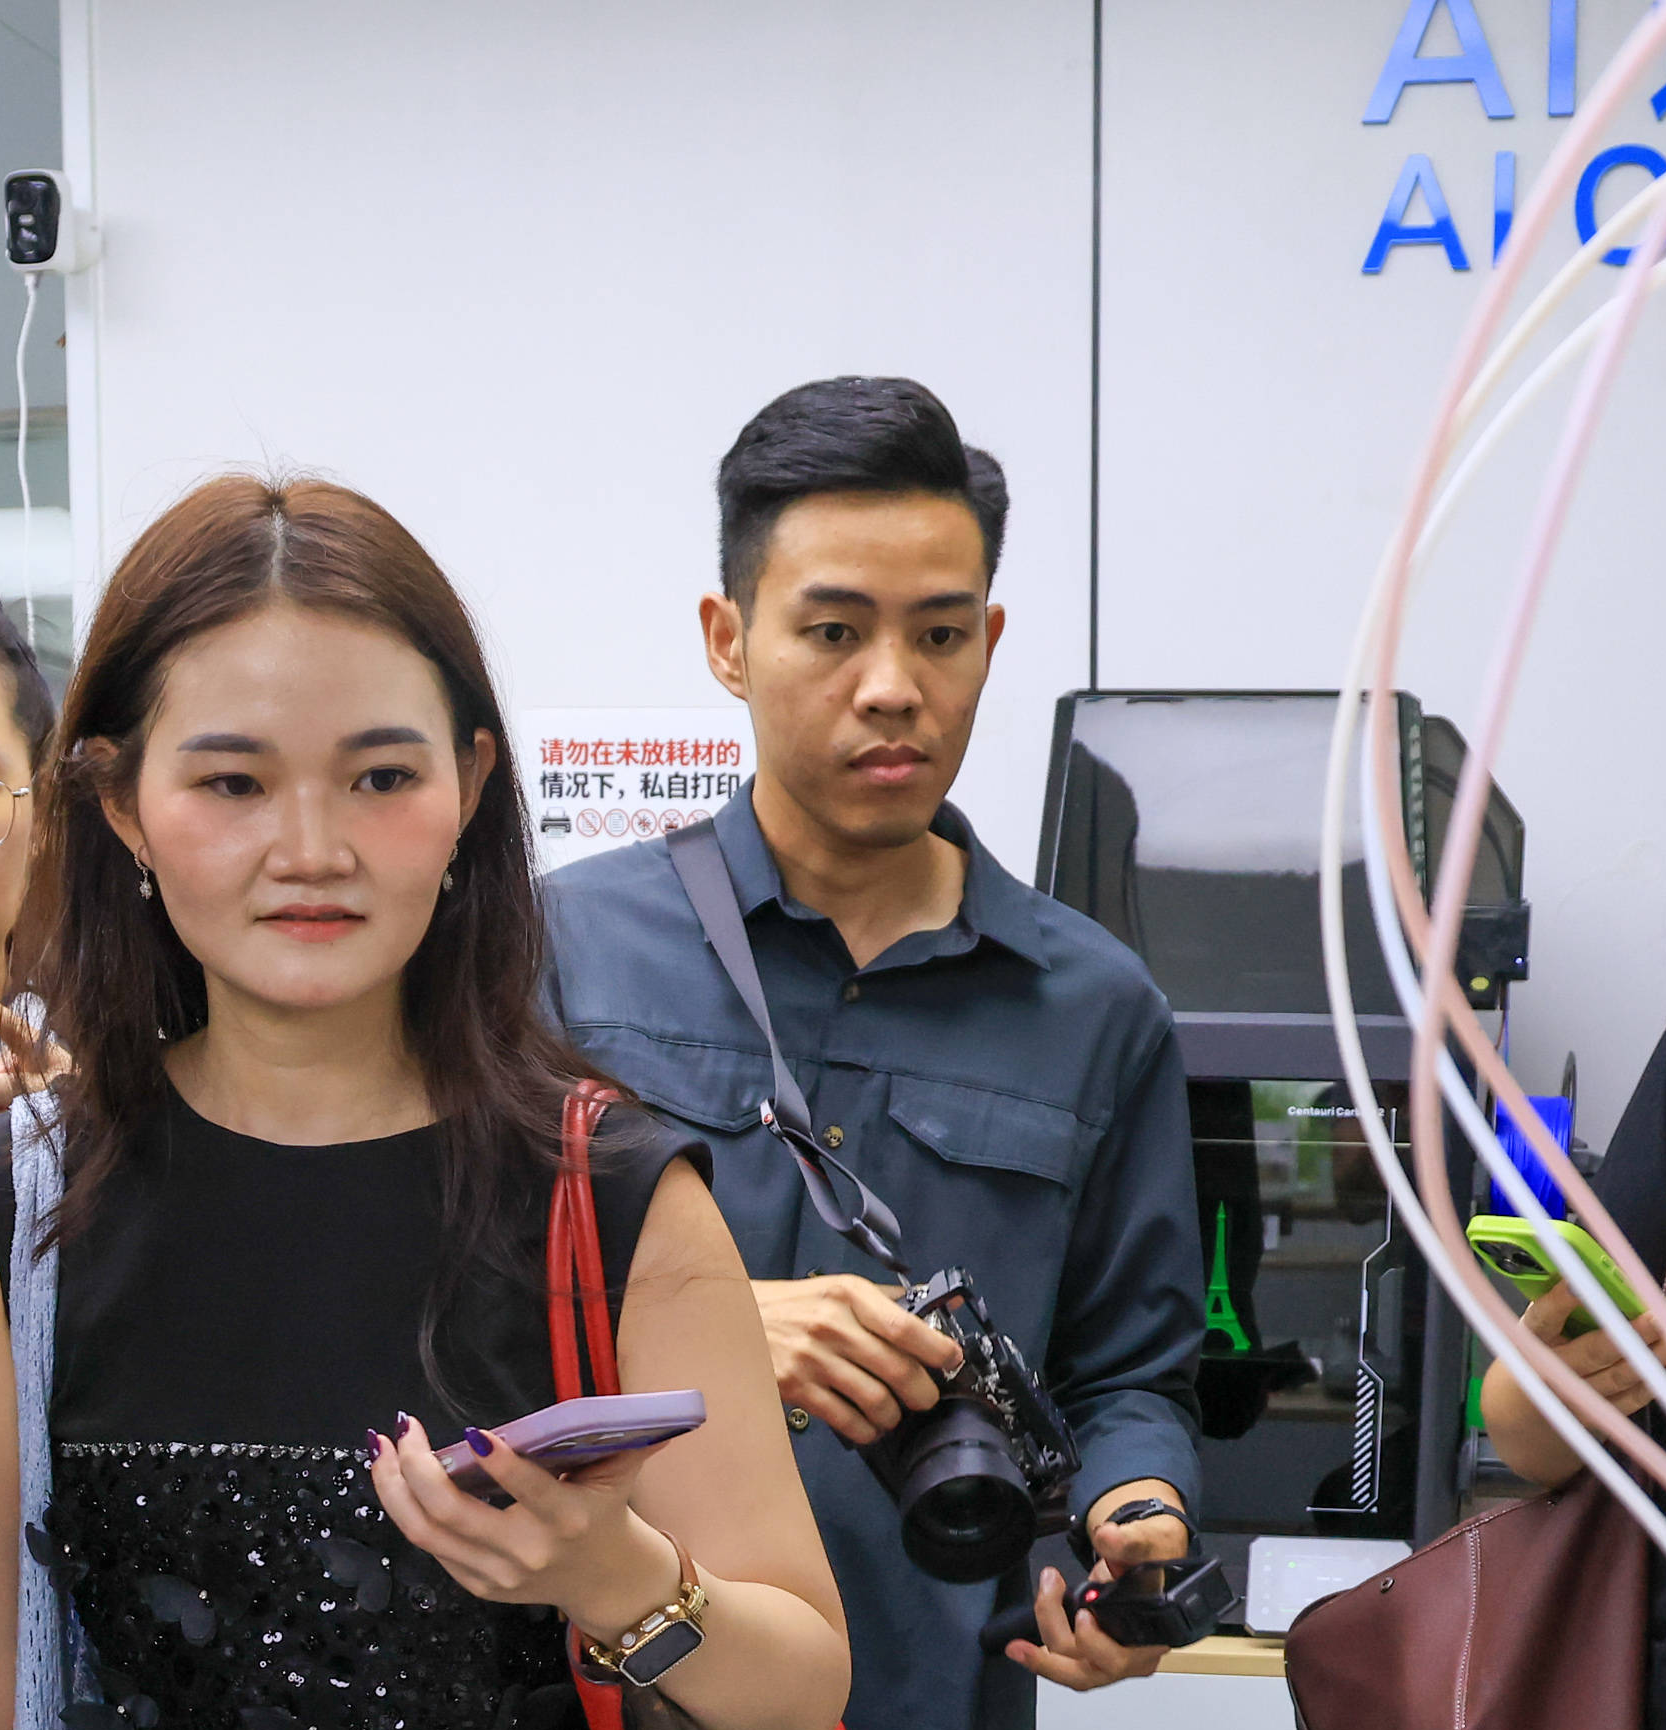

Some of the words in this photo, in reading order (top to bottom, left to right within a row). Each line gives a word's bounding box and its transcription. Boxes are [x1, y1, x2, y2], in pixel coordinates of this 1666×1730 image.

[1362, 150, 1516, 275] AI
[539, 738, 741, 767] 请勿在未放耗材的
[1287, 1106, 1335, 1117] Centauri
